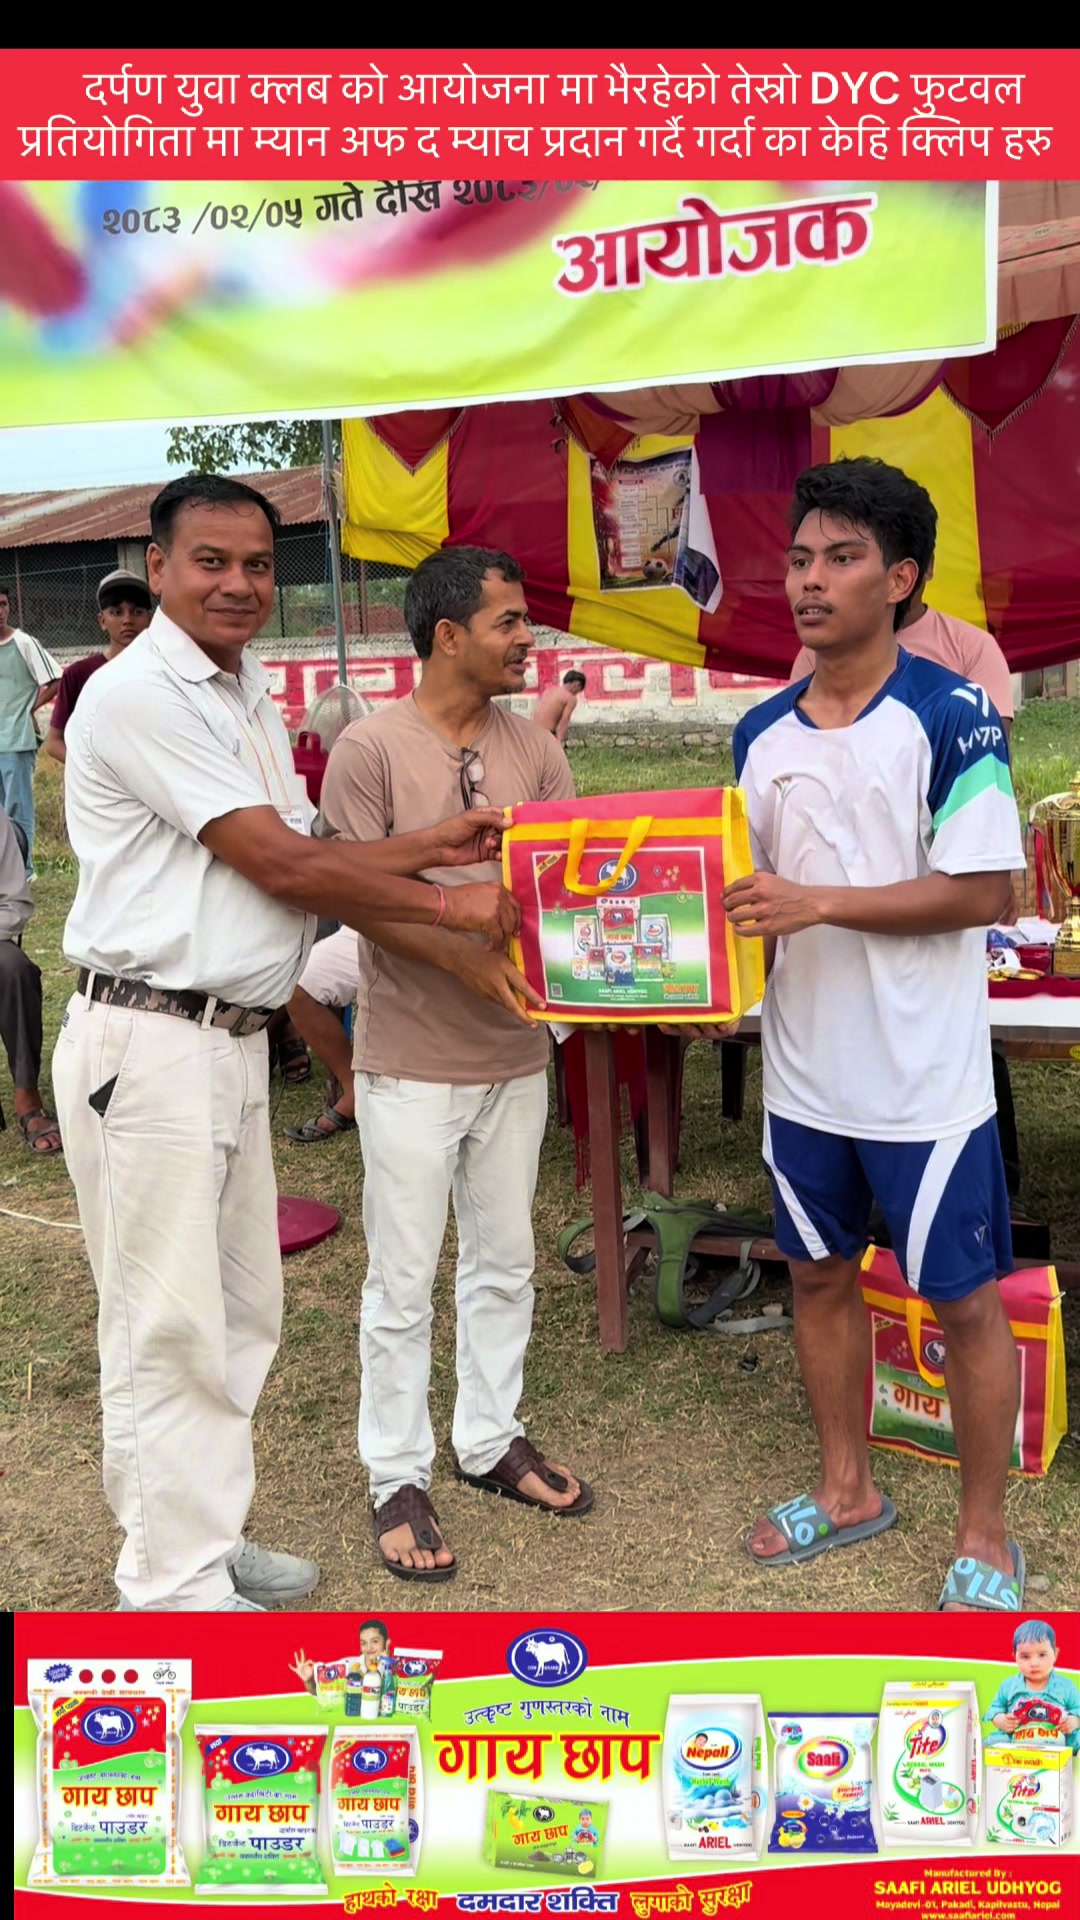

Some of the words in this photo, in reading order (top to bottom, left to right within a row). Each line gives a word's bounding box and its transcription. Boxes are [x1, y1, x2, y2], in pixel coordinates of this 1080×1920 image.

[102, 206, 182, 234] २०८३
[313, 182, 364, 221] गते
[556, 197, 873, 294] आयोजक
[893, 1382, 945, 1419] गाय
